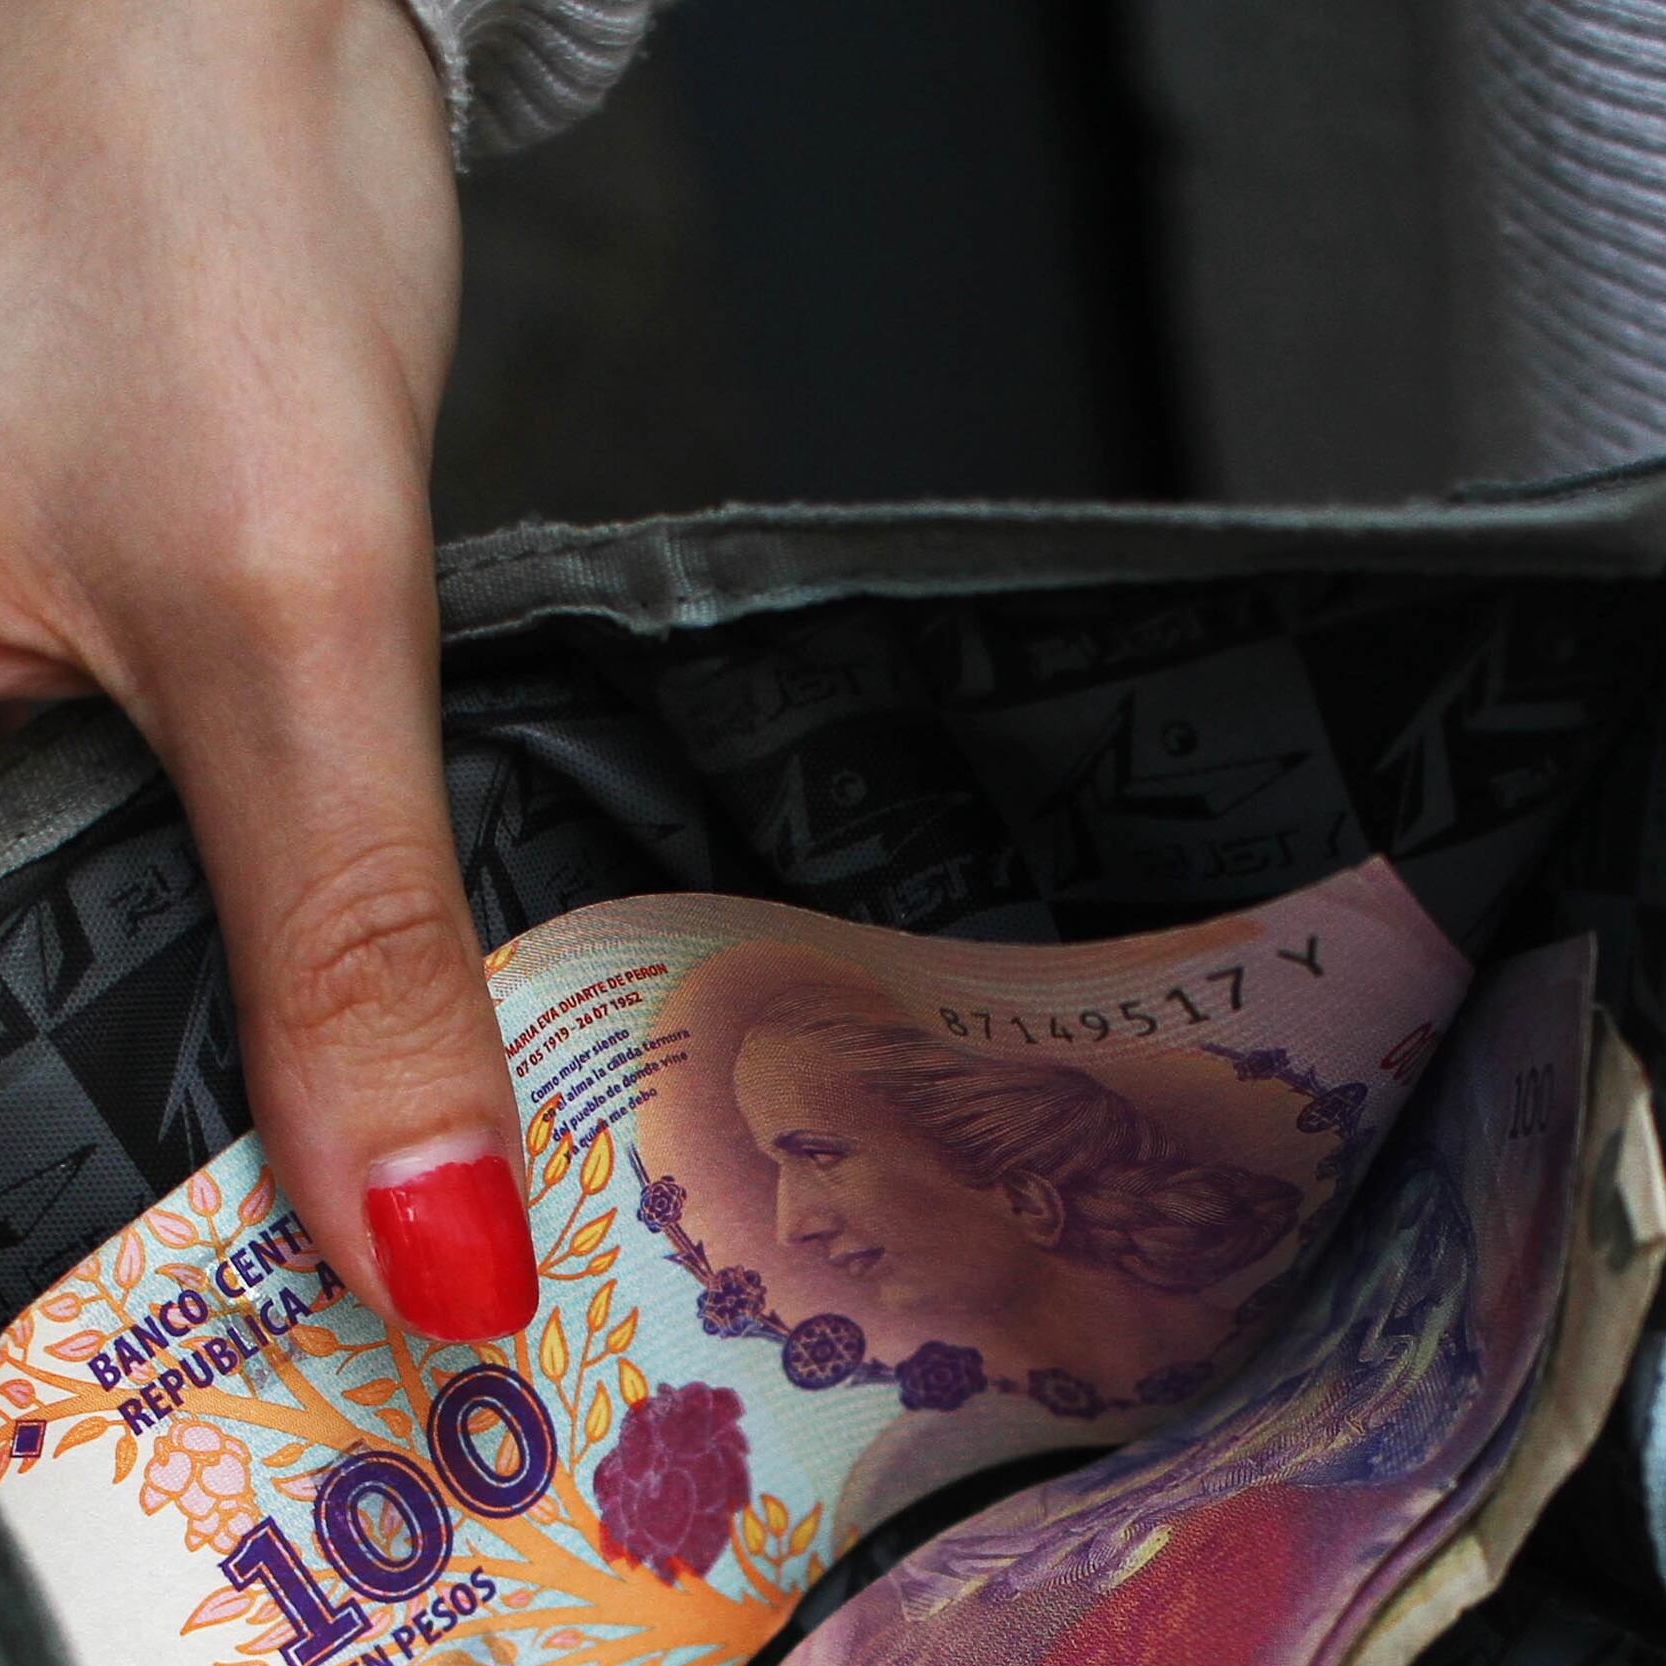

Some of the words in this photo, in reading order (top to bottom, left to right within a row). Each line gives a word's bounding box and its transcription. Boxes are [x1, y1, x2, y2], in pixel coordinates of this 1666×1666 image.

[505, 1025, 539, 1058] MARIA
[537, 1008, 560, 1029] EVA
[559, 981, 608, 1014] DUARTE
[608, 974, 625, 990] DE
[515, 1060, 530, 1078] 07
[528, 1049, 544, 1066] 05
[544, 1026, 569, 1053] 1919
[576, 1012, 593, 1030] 26
[594, 1003, 610, 1019] 07
[611, 991, 643, 1011] 1952
[938, 966, 1247, 1046] 87149517
[1277, 936, 1327, 978] Y
[530, 1075, 559, 1104] Como
[559, 1048, 591, 1080] mujer
[593, 1028, 630, 1055] siento
[541, 1107, 556, 1123] en
[557, 1096, 567, 1112] el
[567, 1077, 594, 1102] alma
[593, 1067, 607, 1081] la
[642, 1028, 690, 1051] ternura
[552, 1121, 569, 1142] del
[569, 1090, 606, 1134] pueblo
[606, 1080, 623, 1099] de
[622, 1061, 660, 1088] donde
[660, 1051, 688, 1067] vine
[578, 1119, 610, 1150] quien
[609, 1106, 628, 1124] me
[629, 1087, 658, 1109] debo
[88, 1288, 208, 1392] BANCO
[214, 1210, 313, 1299] CENT
[116, 1287, 313, 1435] REPUBLICA
[391, 1566, 497, 1660] PESOS
